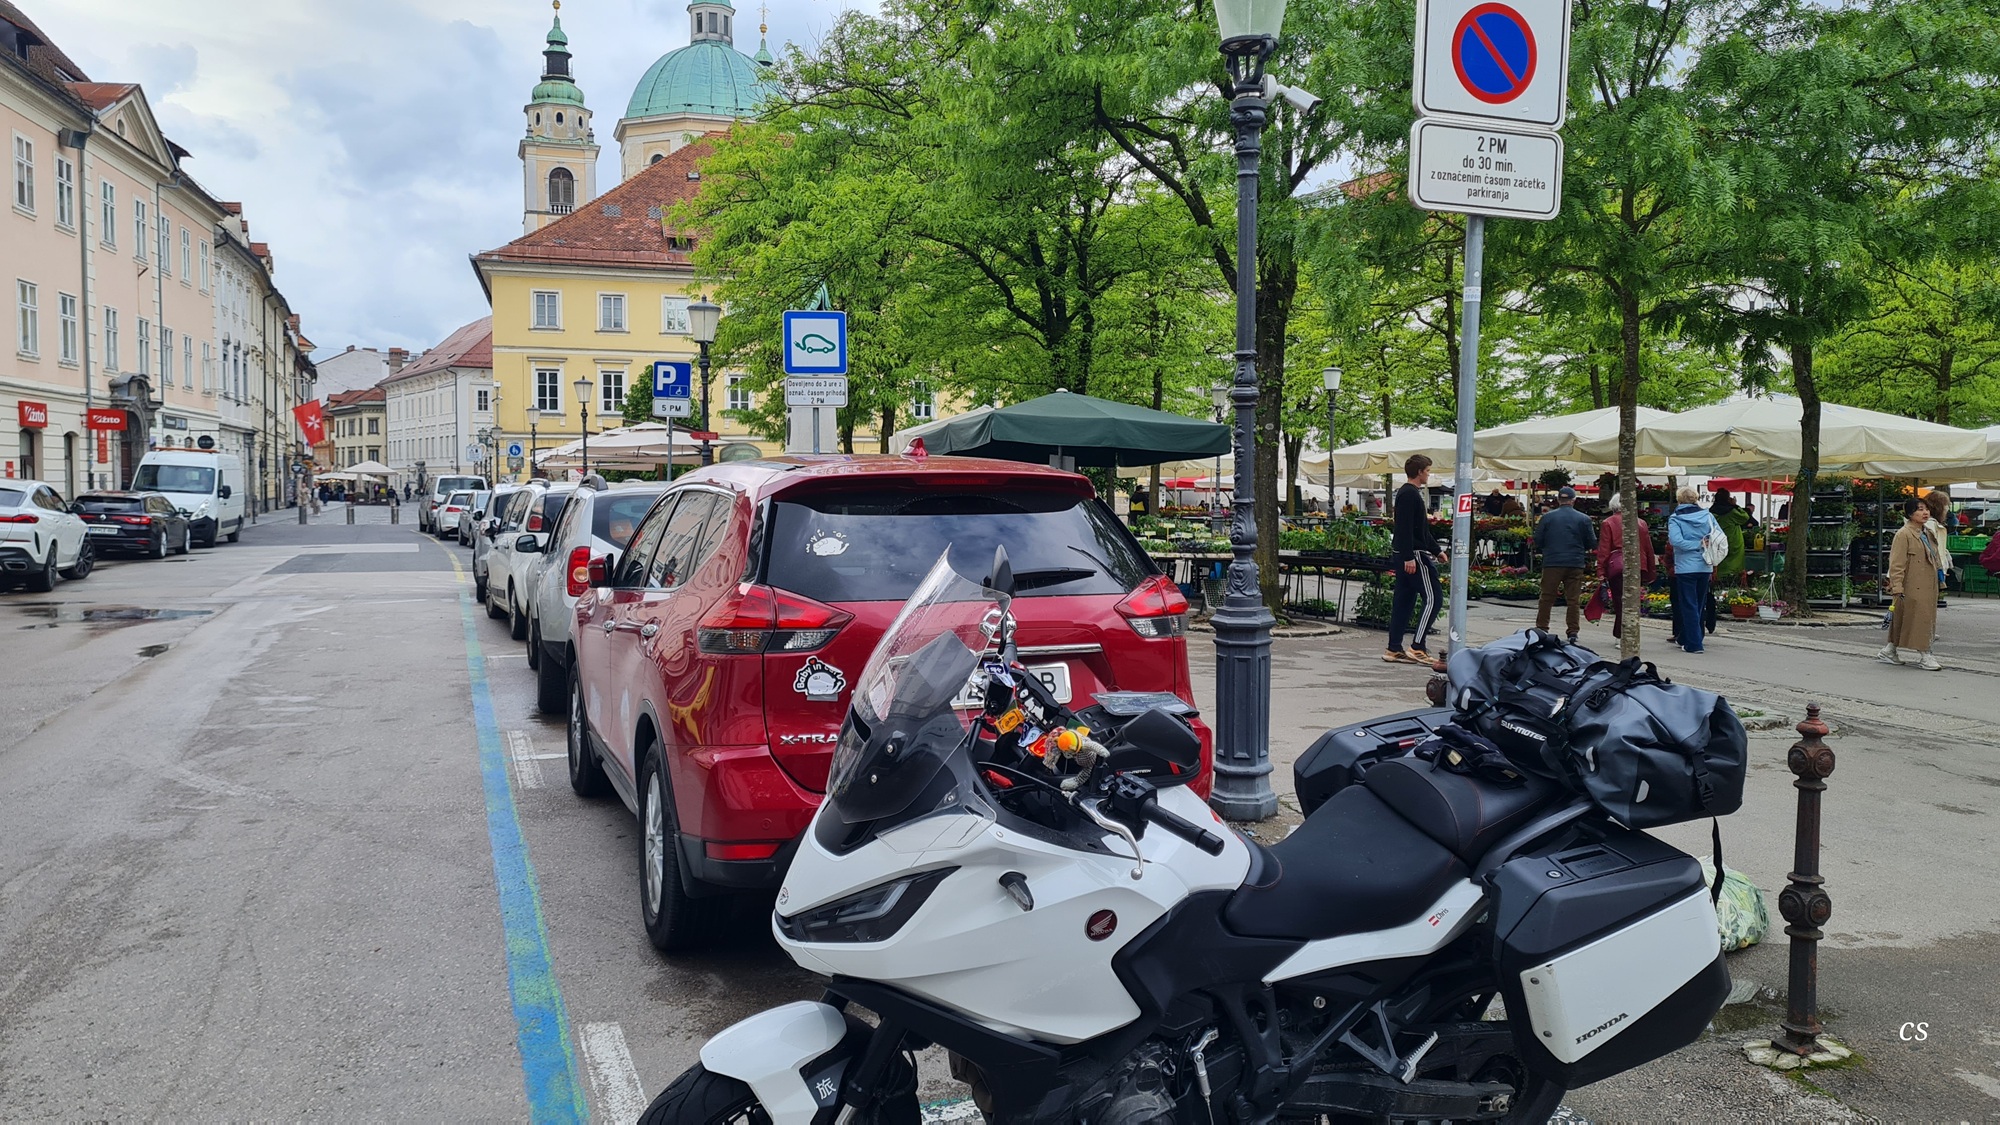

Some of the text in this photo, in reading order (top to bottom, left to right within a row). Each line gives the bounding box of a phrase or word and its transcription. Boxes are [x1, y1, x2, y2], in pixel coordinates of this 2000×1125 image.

[1477, 136, 1508, 154] 2 PM
[1462, 154, 1517, 173] do 30 min.
[1431, 170, 1546, 190] z označenim časom začetka
[1467, 186, 1510, 202] parkiranja
[788, 380, 814, 388] Dovoljeno
[825, 389, 846, 397] prihoda
[661, 404, 682, 413] 5 PM
[796, 666, 812, 689] Baby
[813, 663, 822, 671] in
[1435, 908, 1449, 920] Chris
[1575, 1012, 1629, 1045] HONDA
[815, 1076, 837, 1100] 旅
